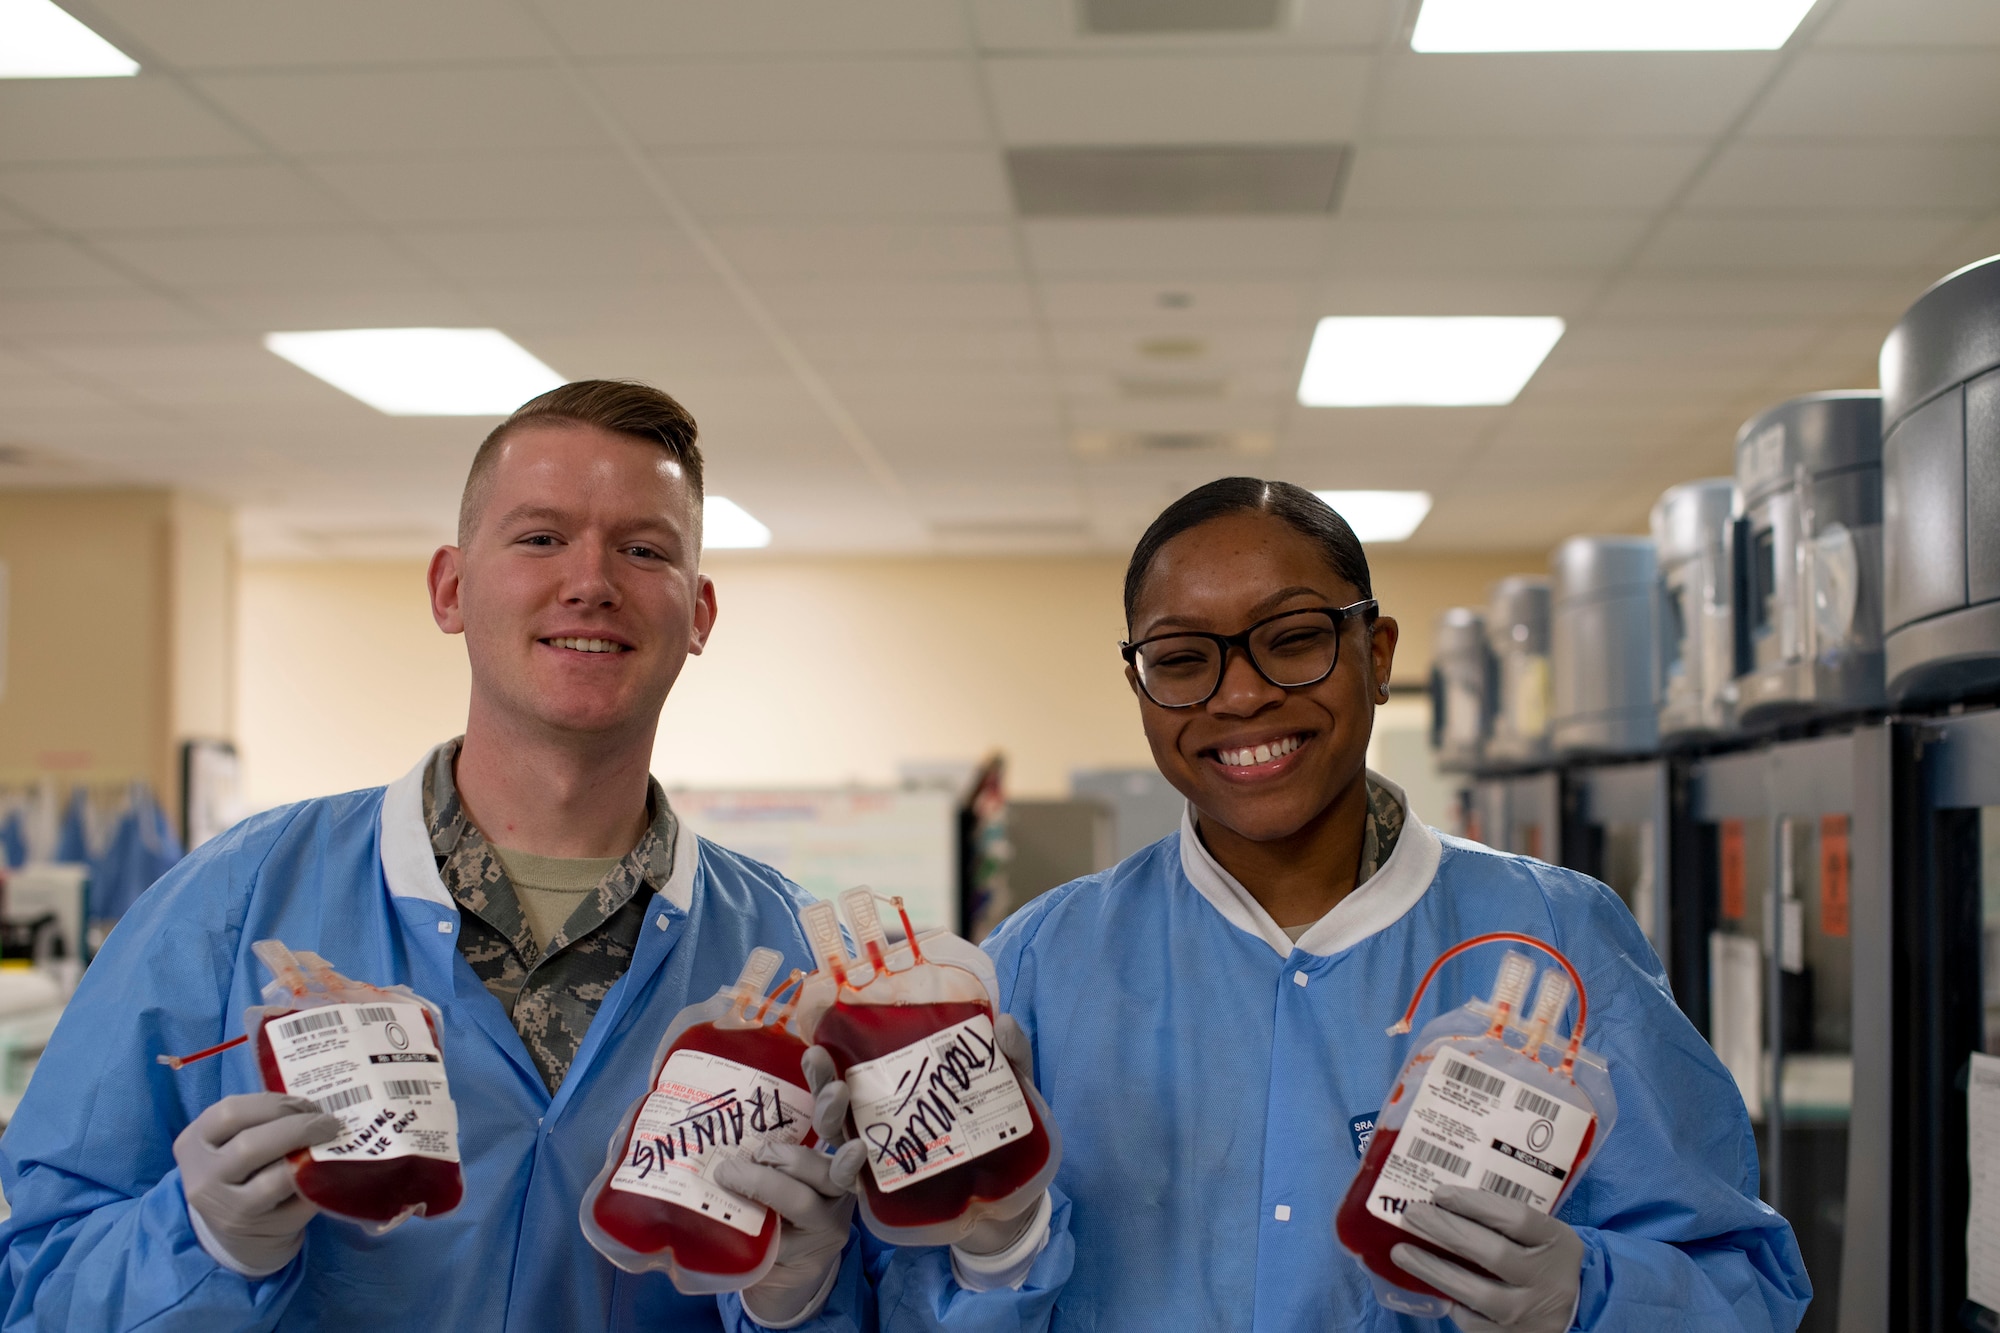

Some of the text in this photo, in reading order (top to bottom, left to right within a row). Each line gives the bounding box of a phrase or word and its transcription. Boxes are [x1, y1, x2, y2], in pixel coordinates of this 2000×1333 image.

[671, 1083, 687, 1093] RED
[687, 1088, 713, 1100] BLOOD
[327, 1108, 397, 1156] TRAINING
[392, 1109, 420, 1134] ONLY
[632, 1086, 794, 1179] TRAINING
[1354, 1119, 1374, 1132] SRA
[639, 1131, 677, 1147] VOLUNR
[676, 1139, 700, 1153] DNOR
[926, 1134, 953, 1152] DONOR
[1499, 1142, 1557, 1176] Rh NEGATIVE
